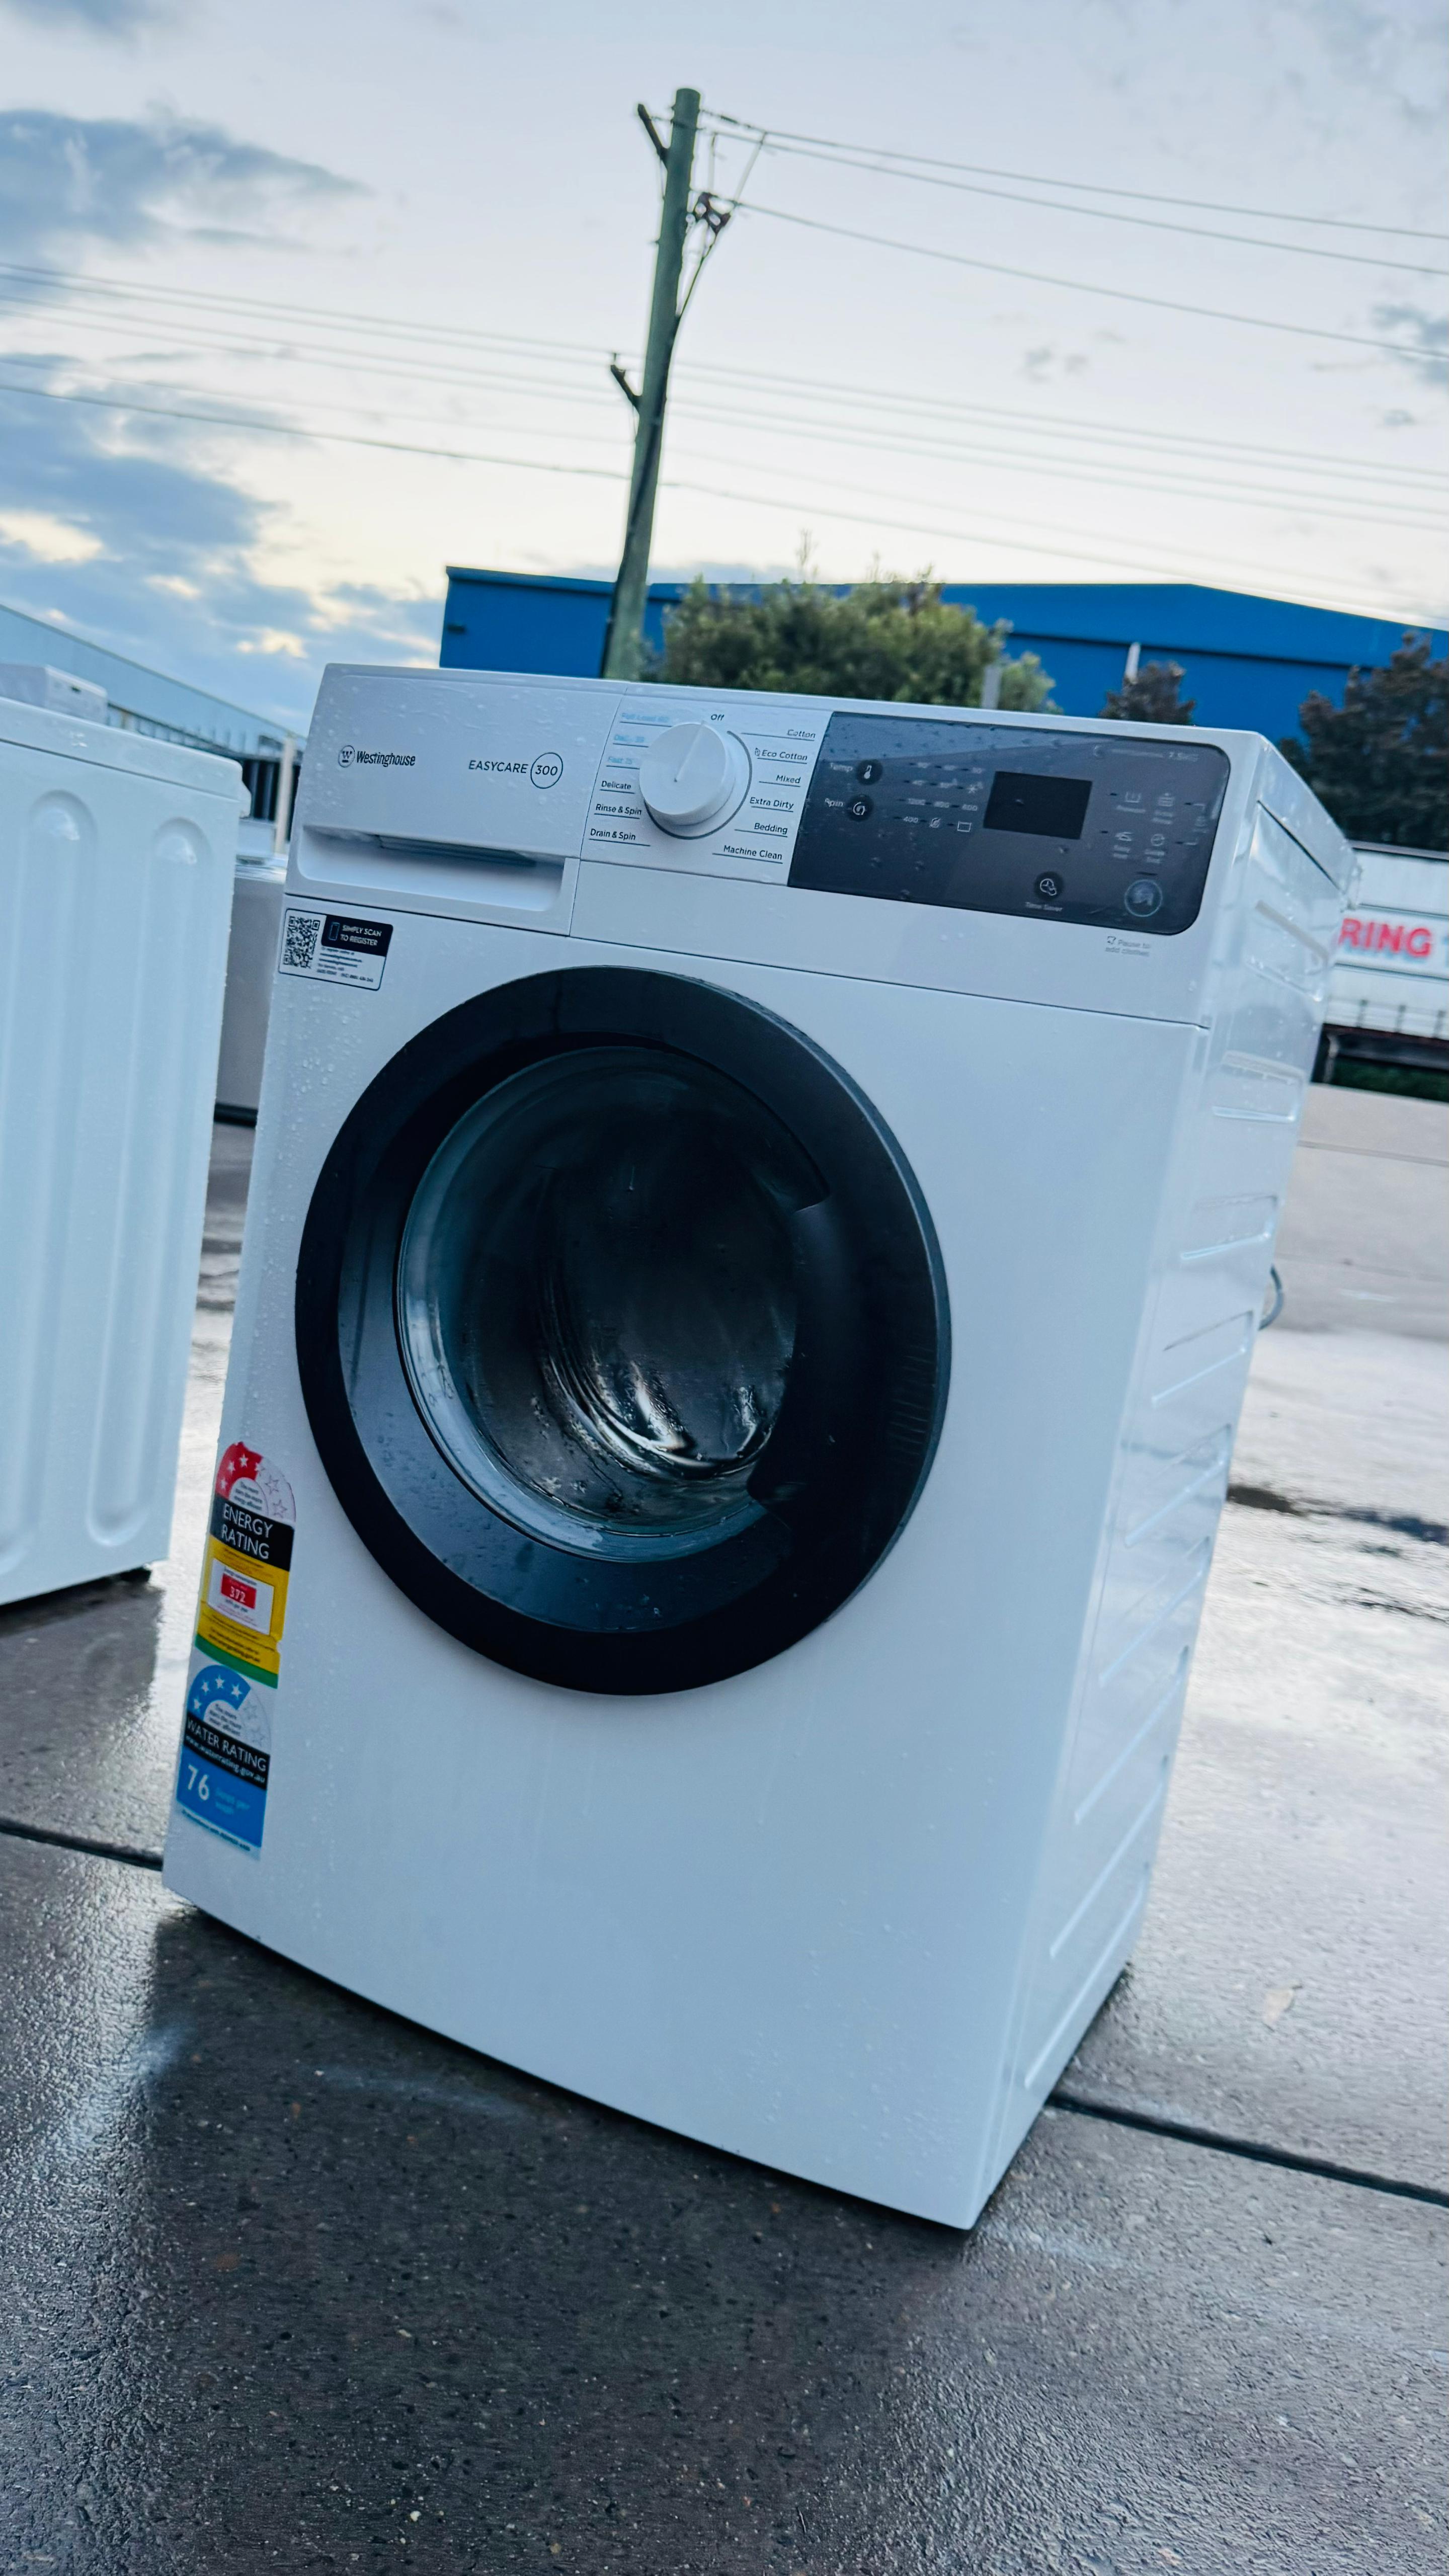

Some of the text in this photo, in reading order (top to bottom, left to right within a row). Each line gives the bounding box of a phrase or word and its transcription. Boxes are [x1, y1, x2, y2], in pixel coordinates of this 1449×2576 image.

[710, 713, 725, 721] Off
[786, 729, 816, 739] Cotton
[356, 750, 416, 768] Westinghouse
[761, 749, 808, 761] Eco Cotton
[468, 760, 558, 776] EASYCARE 300
[830, 762, 853, 773] Temp
[601, 780, 631, 790] Delicate
[776, 774, 801, 784] Mixed
[749, 796, 794, 810] Extra Dirty
[825, 797, 844, 808] Spin
[595, 803, 617, 813] Rinse
[624, 807, 642, 816] Spin
[590, 828, 611, 838] Drain
[618, 832, 636, 841] Spin
[754, 822, 788, 835] Bedding
[723, 845, 783, 860] Machine Clean
[342, 924, 382, 937] SIMPLY SCAN
[340, 934, 378, 946] TO REGISTER
[223, 1503, 273, 1538] ENERGY
[221, 1523, 270, 1560] RATING
[187, 1719, 220, 1749] WATER
[222, 1739, 267, 1772] RATING
[188, 1764, 210, 1801] 76
